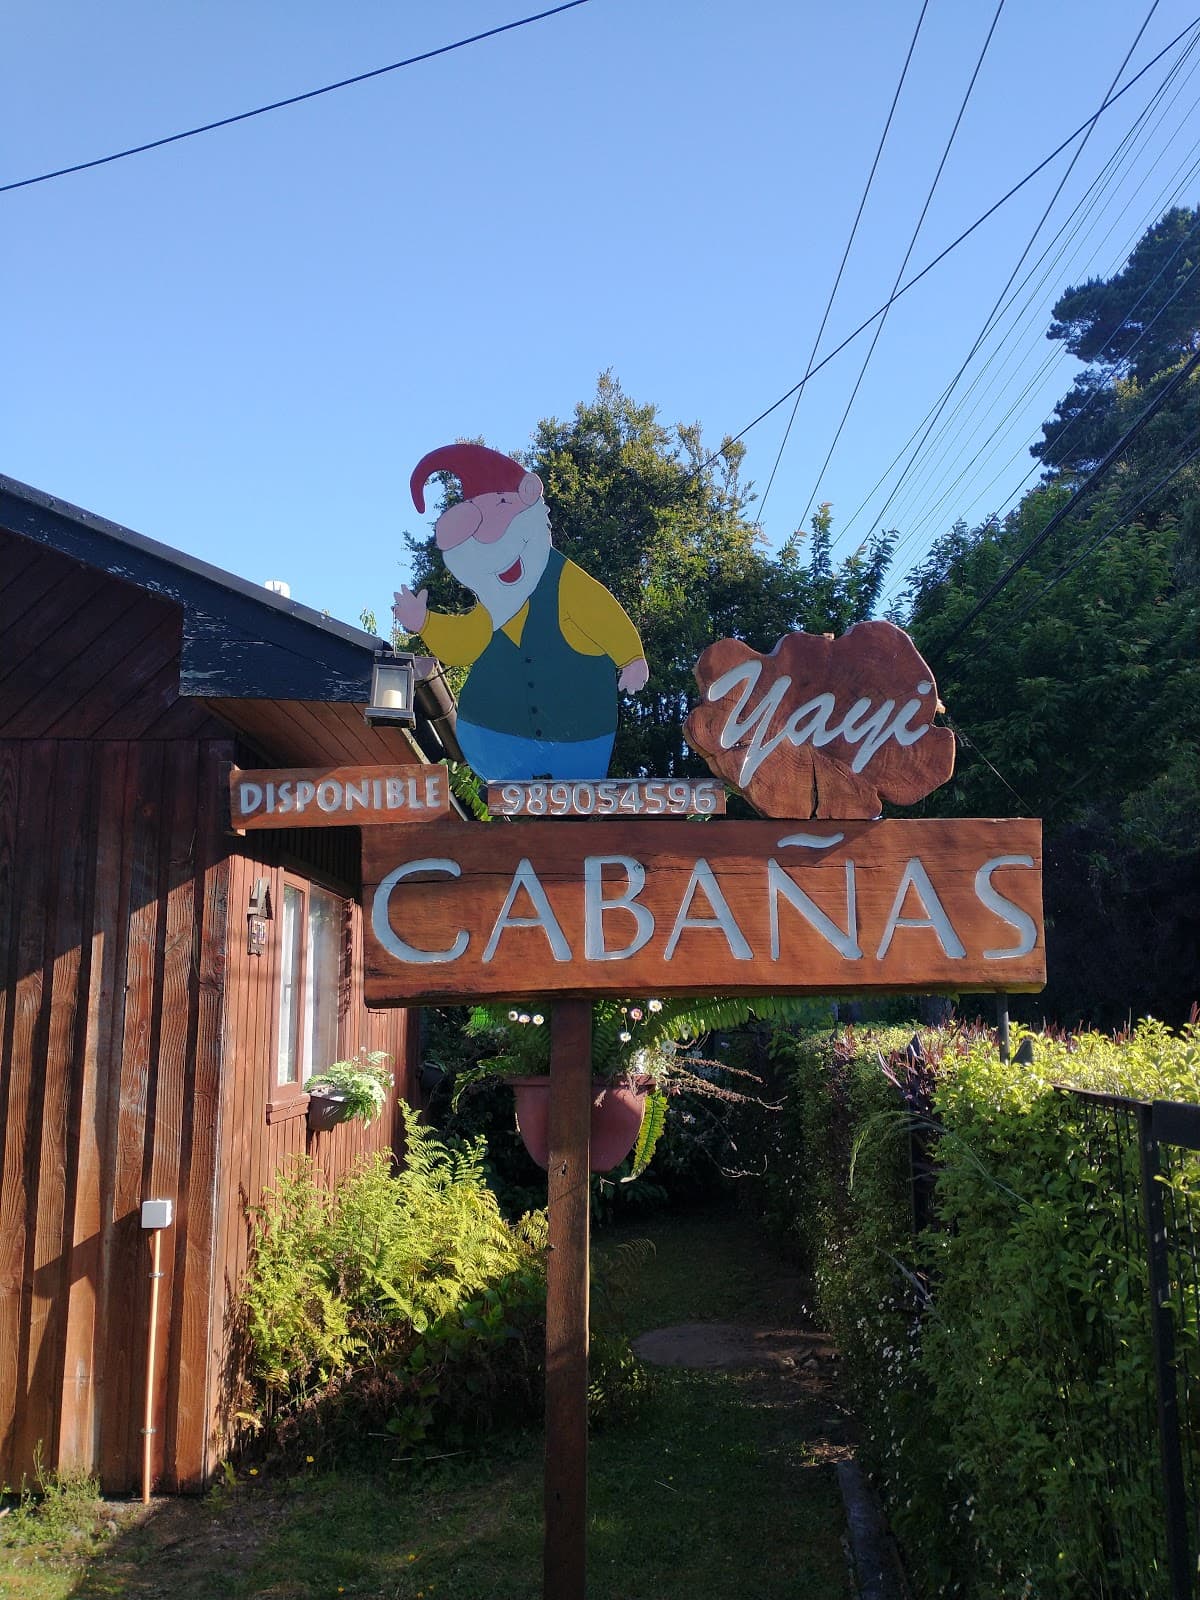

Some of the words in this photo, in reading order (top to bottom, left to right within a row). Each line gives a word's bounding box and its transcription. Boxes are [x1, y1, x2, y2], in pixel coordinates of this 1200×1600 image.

[708, 659, 934, 788] Yayi
[240, 777, 441, 814] DISPONIBLE
[502, 782, 717, 815] 989054596
[371, 832, 1038, 963] CABAÑAS
